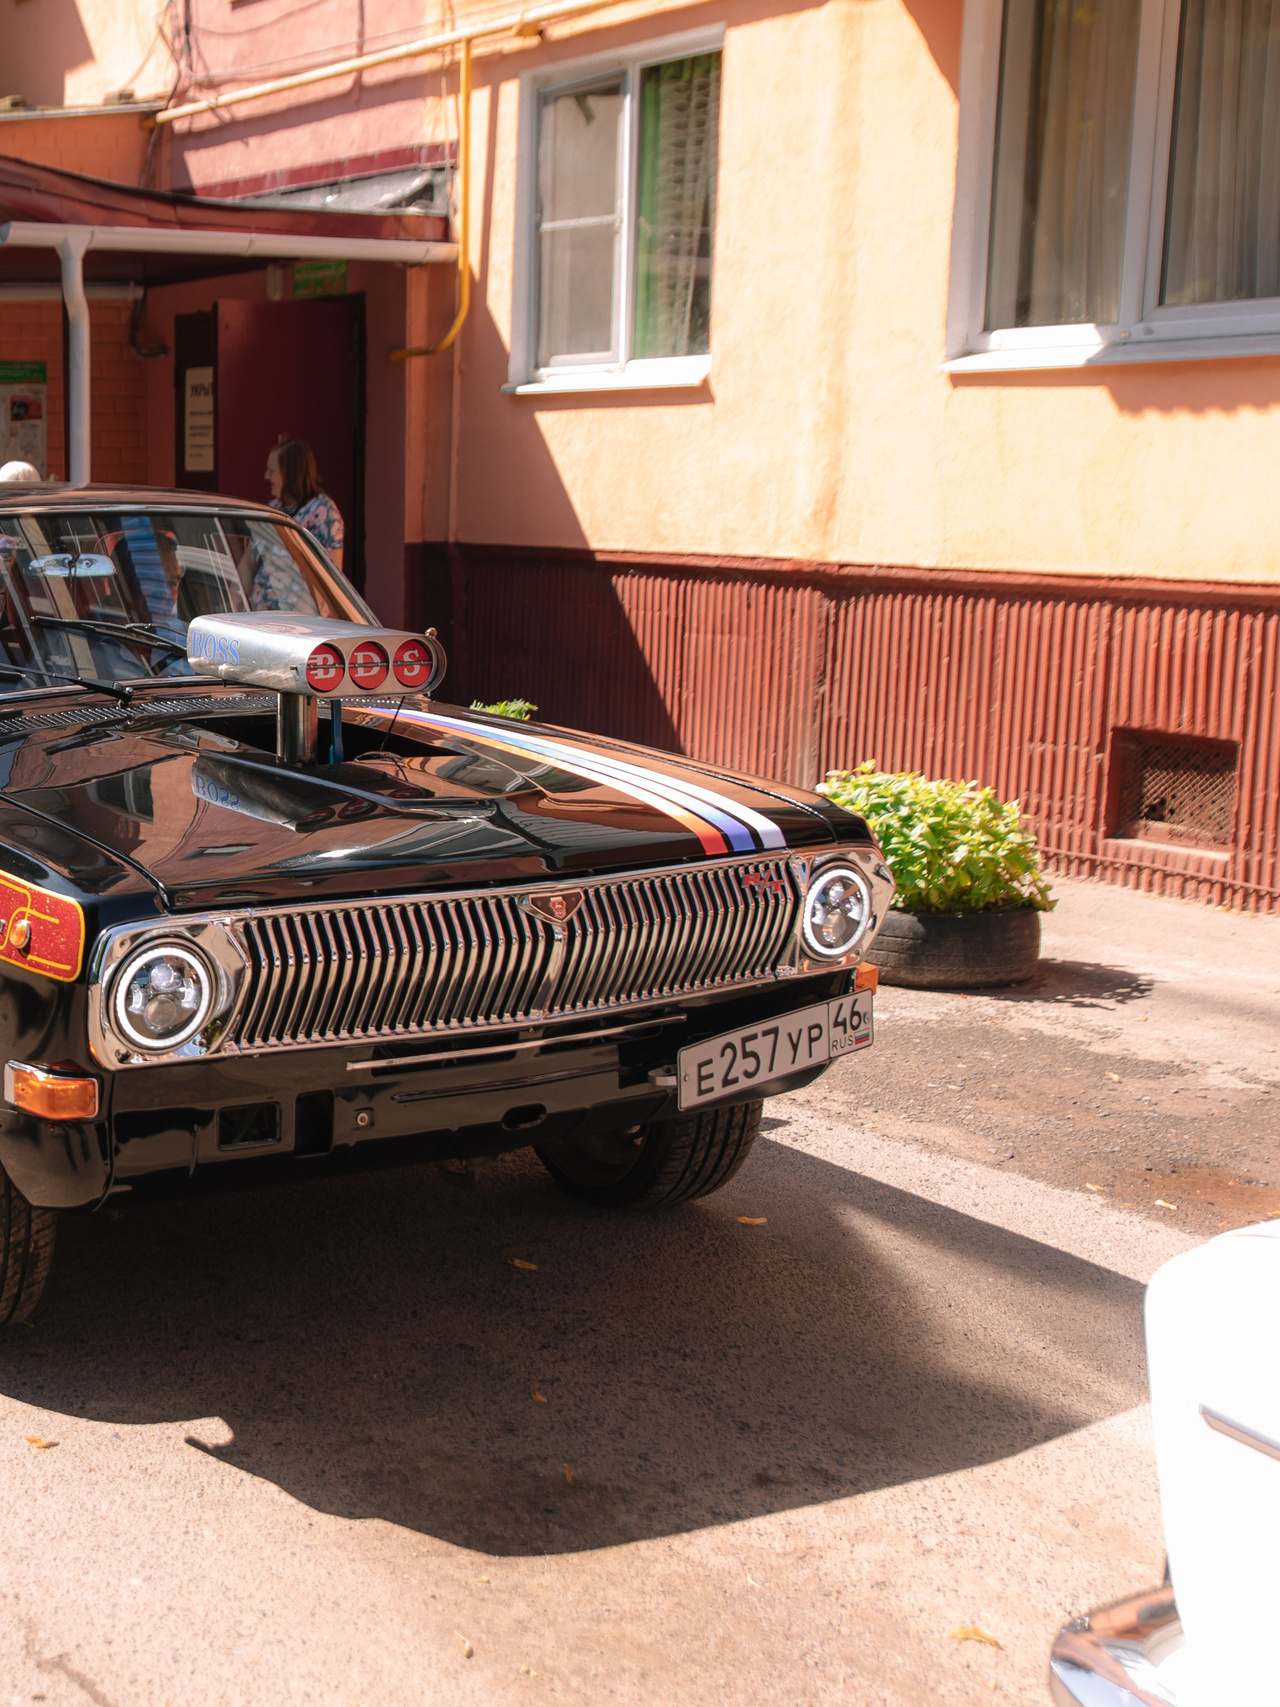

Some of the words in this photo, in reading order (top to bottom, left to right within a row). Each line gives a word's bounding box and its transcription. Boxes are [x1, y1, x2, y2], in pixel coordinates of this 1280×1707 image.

[192, 631, 240, 666] BOSS
[742, 869, 785, 898] R/T
[697, 1023, 824, 1097] Е257УР
[833, 998, 862, 1035] 46
[832, 1034, 854, 1052] RUS
